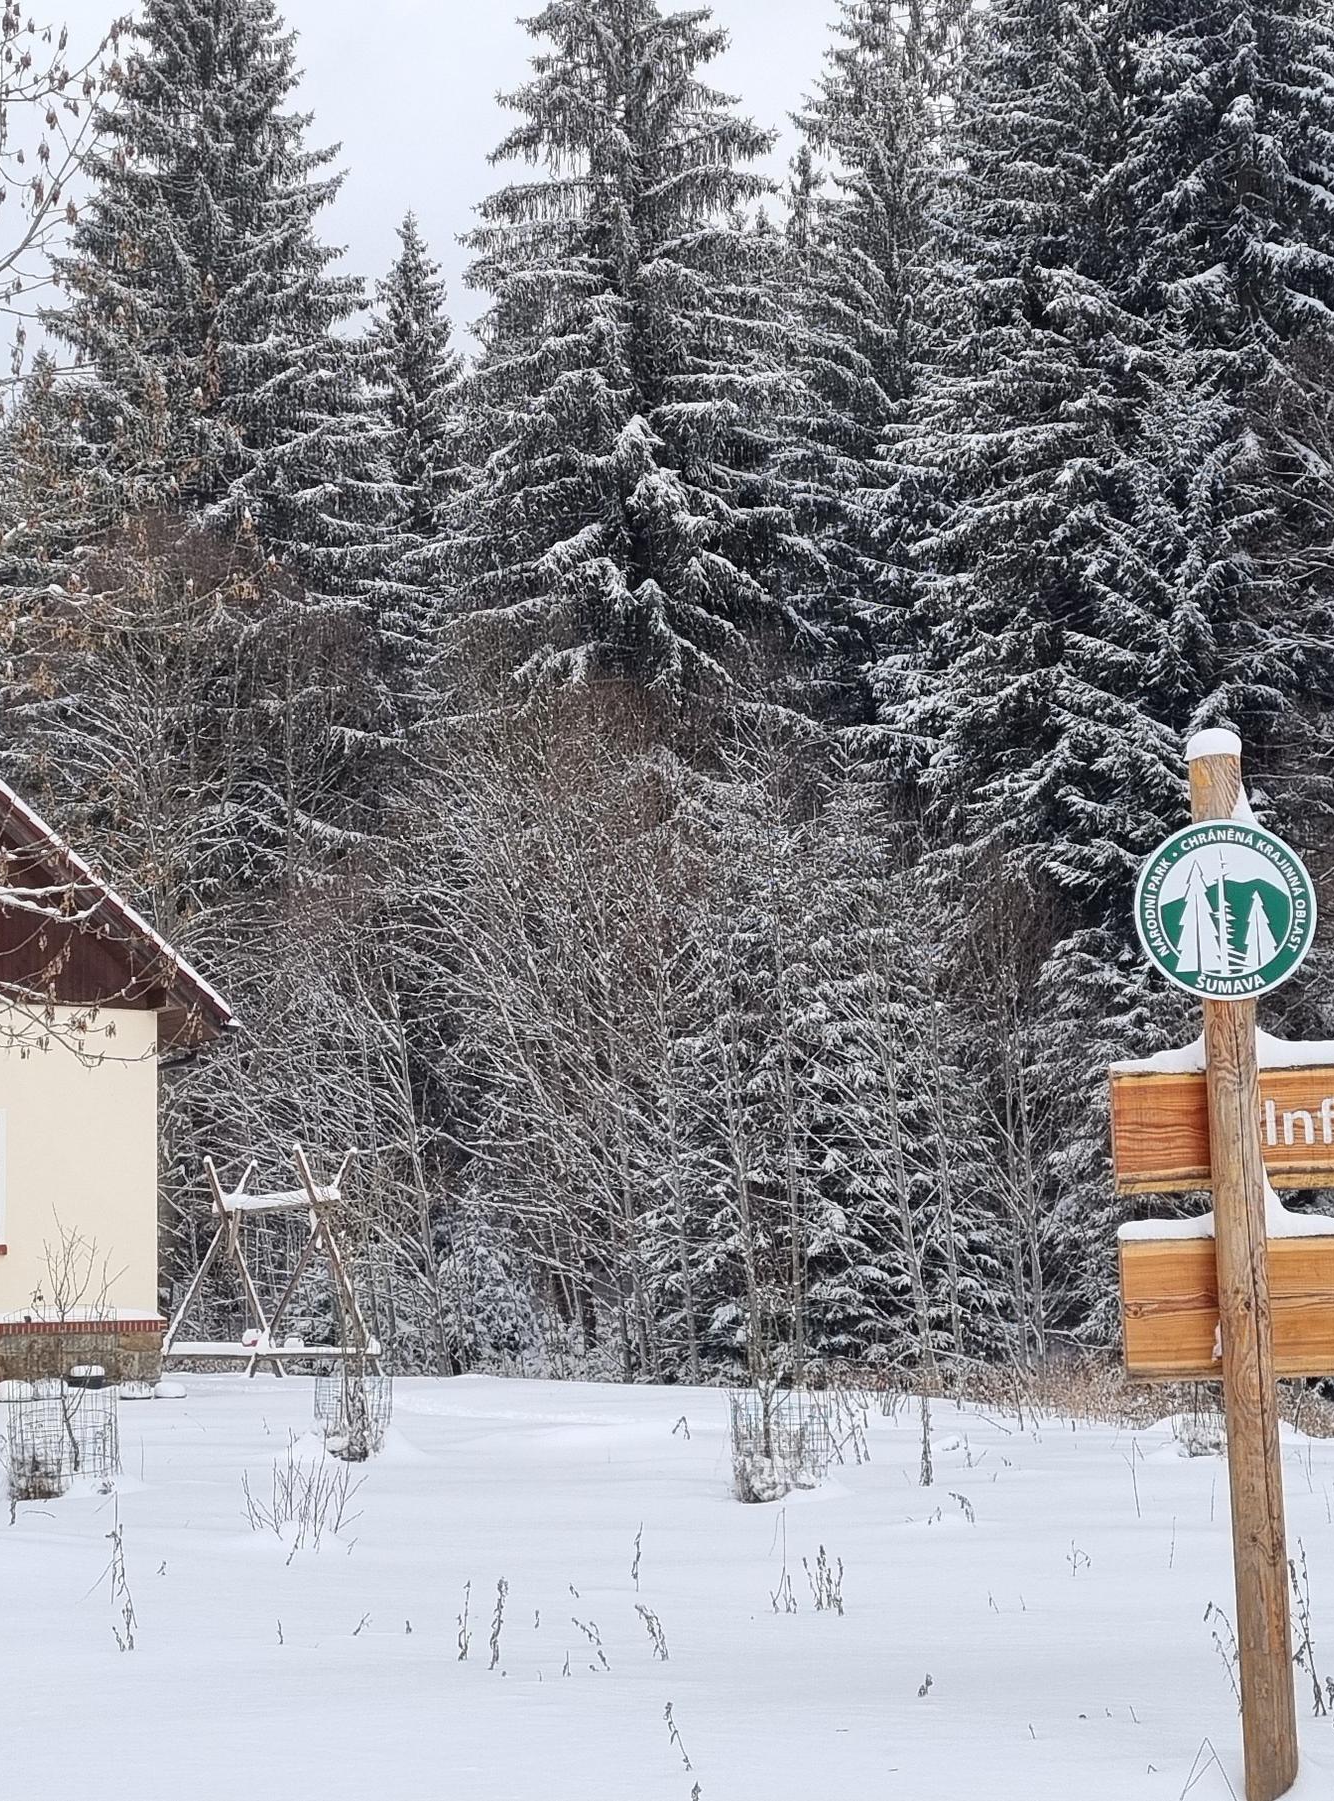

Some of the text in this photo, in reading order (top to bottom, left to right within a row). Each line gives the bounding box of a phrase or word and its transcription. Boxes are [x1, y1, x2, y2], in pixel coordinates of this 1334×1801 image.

[1144, 829, 1306, 957] NÁRODNÍ PARK CHRÁNĚNÁ KRAJINNÁ OBLAST
[1195, 974, 1266, 993] ŠUMAVA
